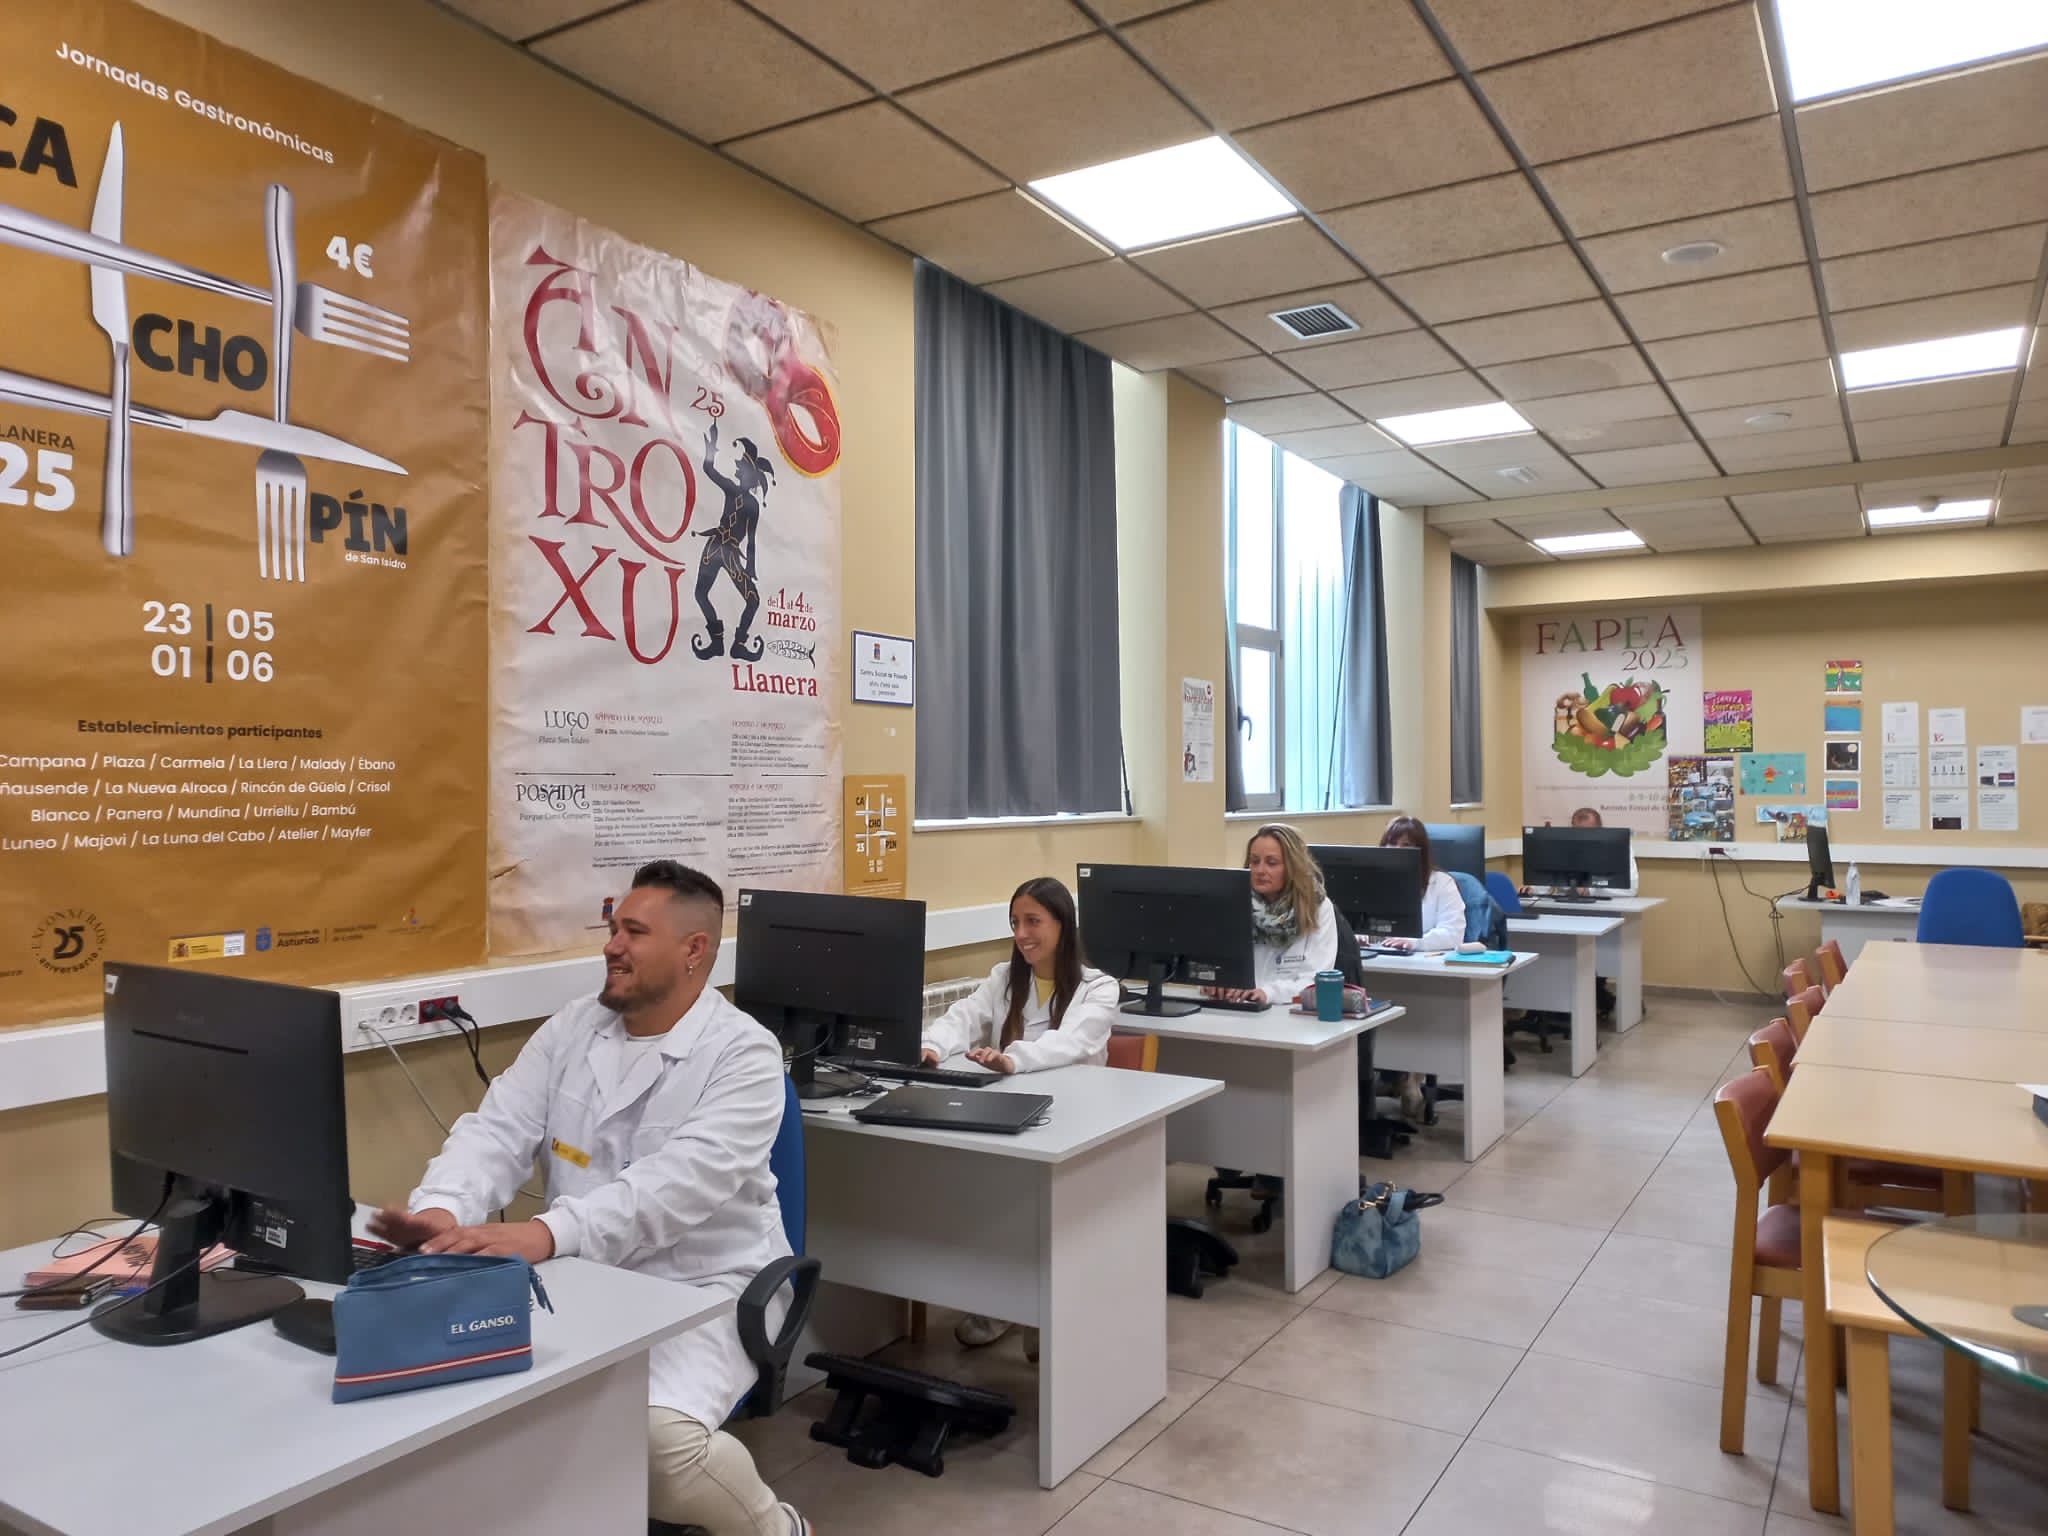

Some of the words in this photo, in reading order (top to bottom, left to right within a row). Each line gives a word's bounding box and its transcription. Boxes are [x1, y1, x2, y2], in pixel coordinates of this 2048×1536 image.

[56, 42, 169, 101] Jornadas
[174, 90, 334, 165] Gastronómicas
[326, 236, 373, 278] 4€
[133, 314, 267, 391] CHO
[513, 409, 696, 566] TRO
[310, 488, 407, 555] PÍN
[345, 552, 358, 562] de
[360, 554, 380, 566] San
[382, 557, 406, 569] Isidro
[526, 535, 686, 664] XU
[768, 596, 778, 608] del
[778, 588, 786, 610] 1
[795, 592, 804, 612] 4
[143, 601, 192, 635] 23
[227, 608, 274, 641] 05
[768, 610, 816, 632] marzo
[1536, 613, 1684, 655] FAPEA
[151, 644, 192, 678] 01
[227, 650, 274, 682] 06
[1622, 648, 1689, 671] 2025
[732, 664, 818, 697] Llanera
[78, 719, 224, 736] Establecimientos
[227, 726, 322, 740] participantes
[544, 710, 589, 736] LUGO
[103, 756, 145, 768] Plaza
[160, 757, 224, 768] Carmela
[240, 758, 254, 768] La
[257, 758, 287, 769] Llera
[300, 758, 346, 772] Malady
[358, 758, 396, 770] Ébano
[105, 782, 122, 794] La
[128, 783, 176, 794] Nueva
[180, 782, 227, 794] Alroca
[240, 780, 285, 793] Rincón
[289, 782, 305, 792] de
[357, 782, 390, 792] Crisol
[516, 784, 590, 812] POSADA
[32, 809, 90, 822] Blanco
[106, 808, 162, 820] Panera
[254, 806, 299, 817] Urriellu
[311, 804, 356, 816] Bambú
[2, 838, 56, 850] Luneo
[74, 834, 126, 851] Majovi
[142, 834, 160, 845] La
[163, 832, 198, 844] Luna
[202, 831, 224, 843] del
[227, 830, 265, 841] Cabo
[278, 828, 319, 840] Atelier
[54, 926, 85, 960] 25
[278, 936, 320, 948] Asturias
[450, 1324, 466, 1334] EL
